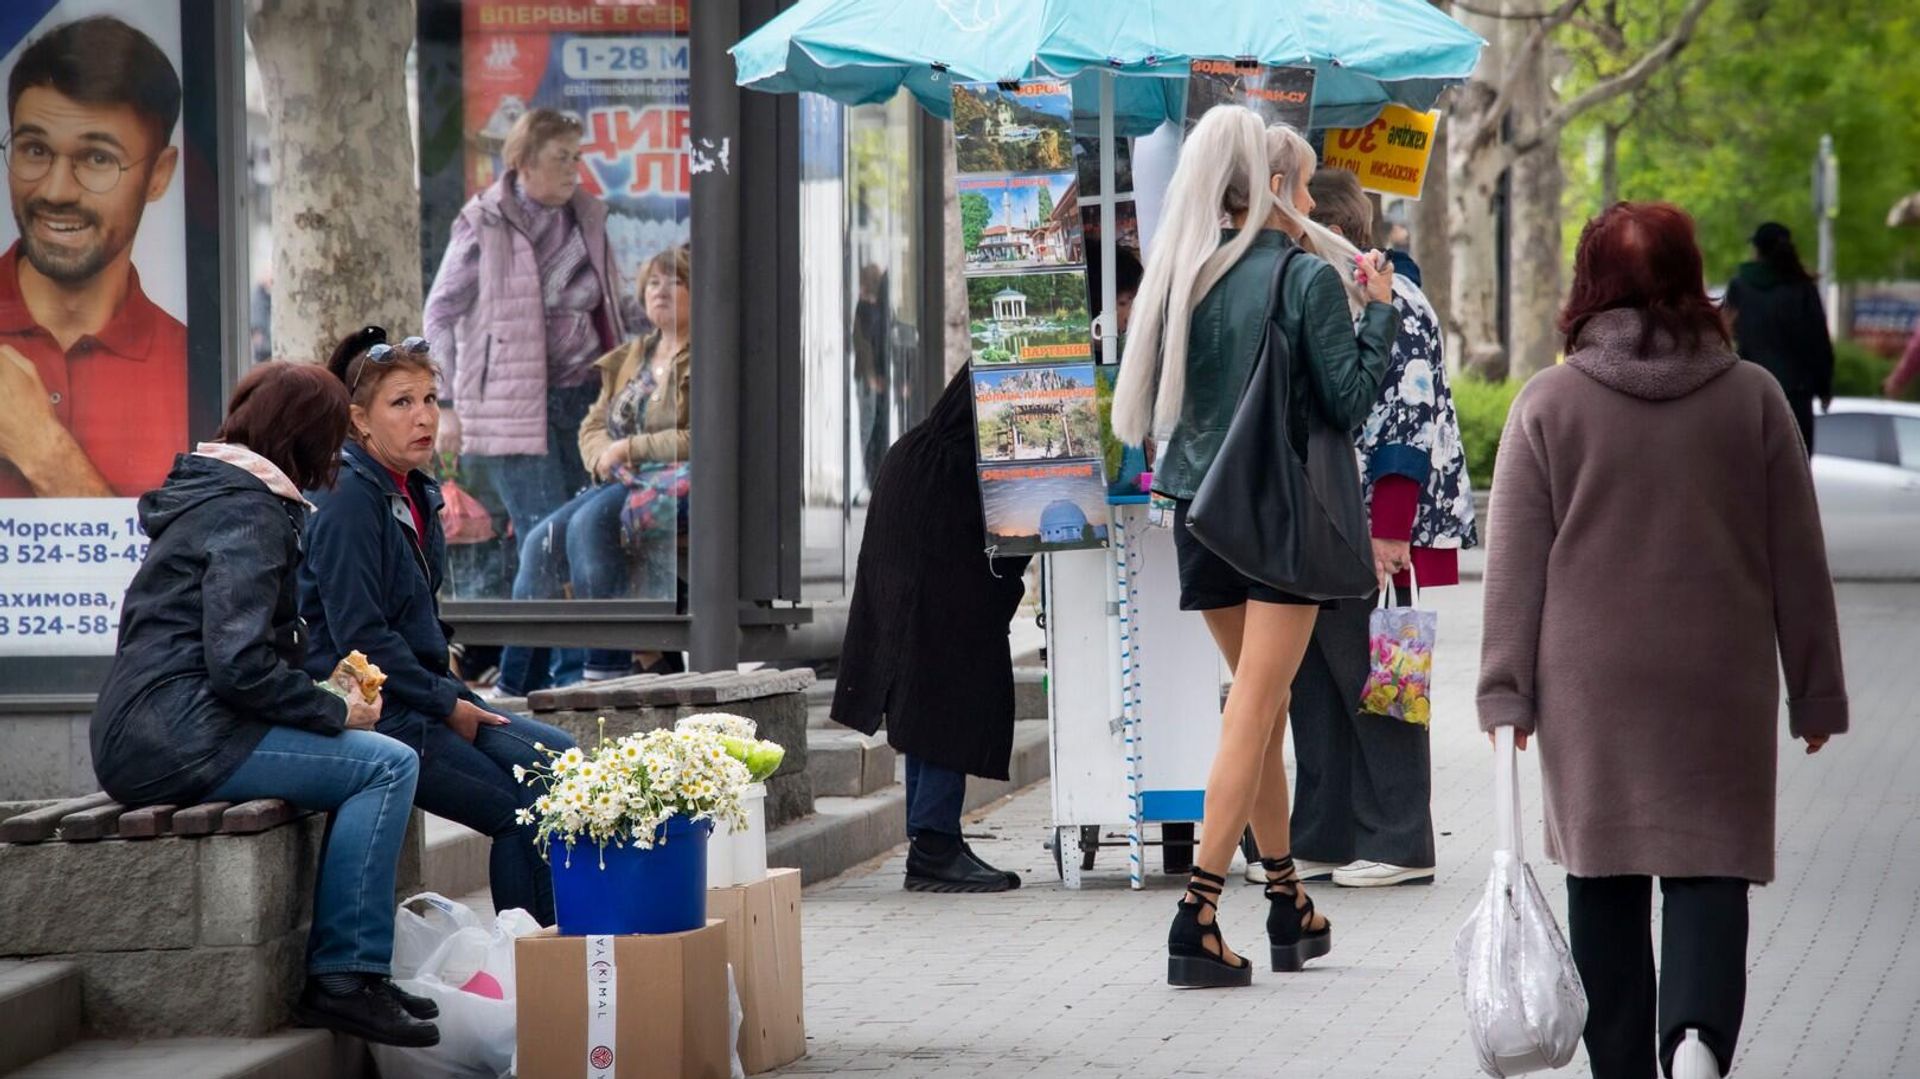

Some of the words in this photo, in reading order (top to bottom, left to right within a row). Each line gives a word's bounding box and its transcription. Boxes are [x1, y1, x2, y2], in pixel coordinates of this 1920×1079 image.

[480, 5, 604, 24] ВПЕРВЫЕ
[613, 6, 629, 24] В
[637, 5, 687, 24] СЕВ
[0, 518, 118, 541] Морская,
[17, 544, 150, 563] 524-58-45
[0, 592, 116, 610] ахимова,
